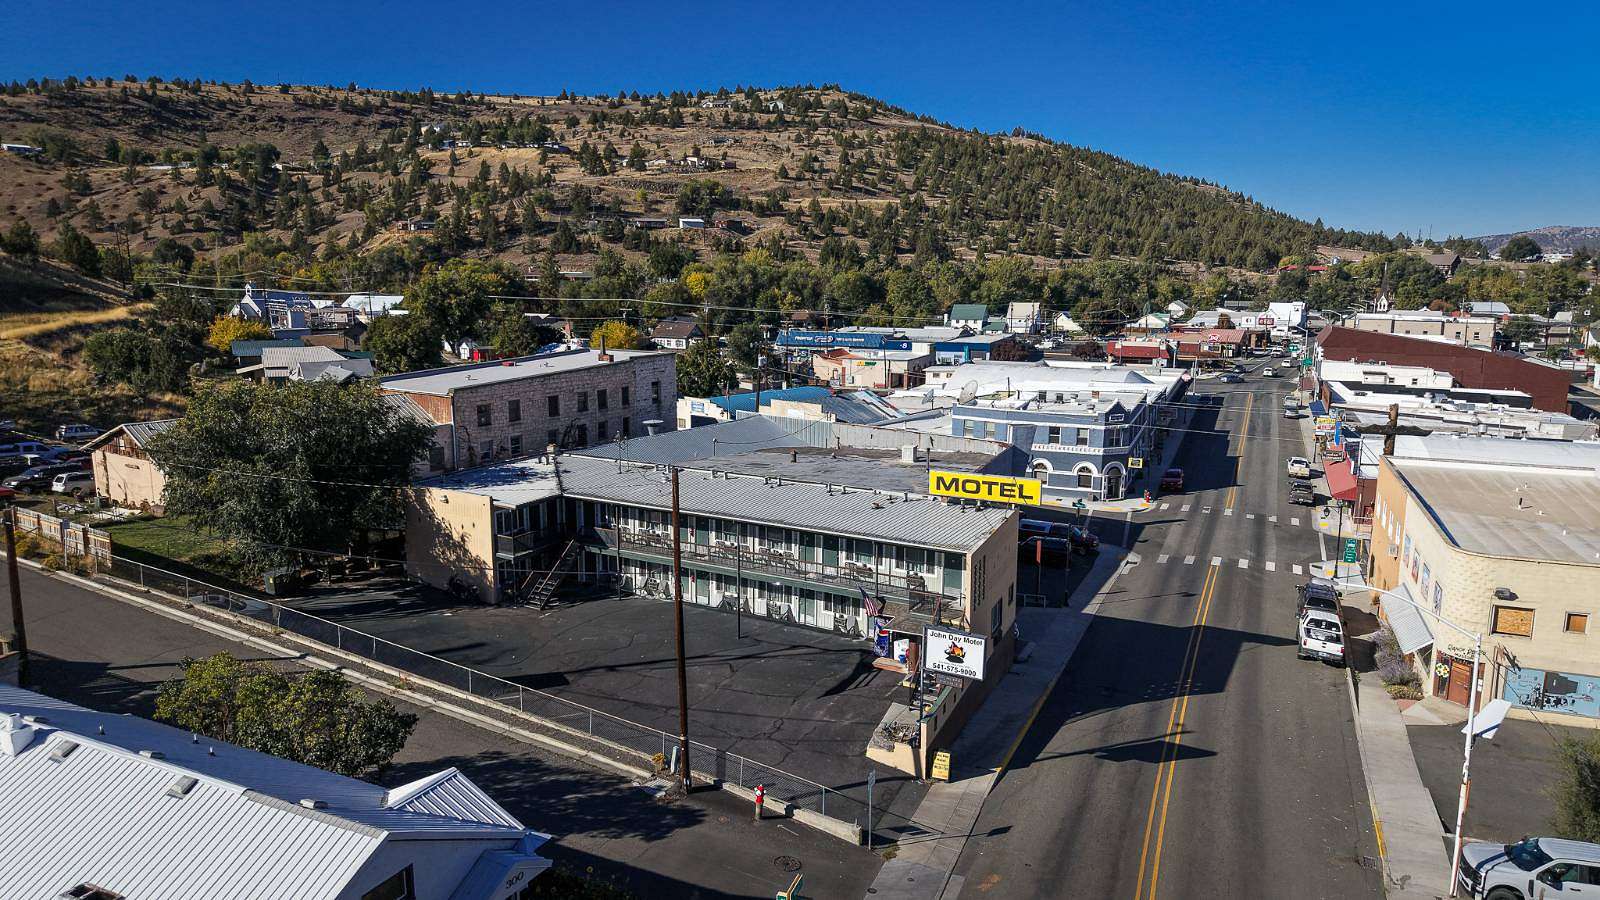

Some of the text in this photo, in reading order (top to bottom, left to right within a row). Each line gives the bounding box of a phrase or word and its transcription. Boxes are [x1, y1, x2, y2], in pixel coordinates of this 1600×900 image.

[936, 476, 1033, 499] MOTEL
[930, 631, 982, 646] John Day Motel
[933, 663, 976, 676] 541-575-9000
[506, 872, 523, 888] 300
